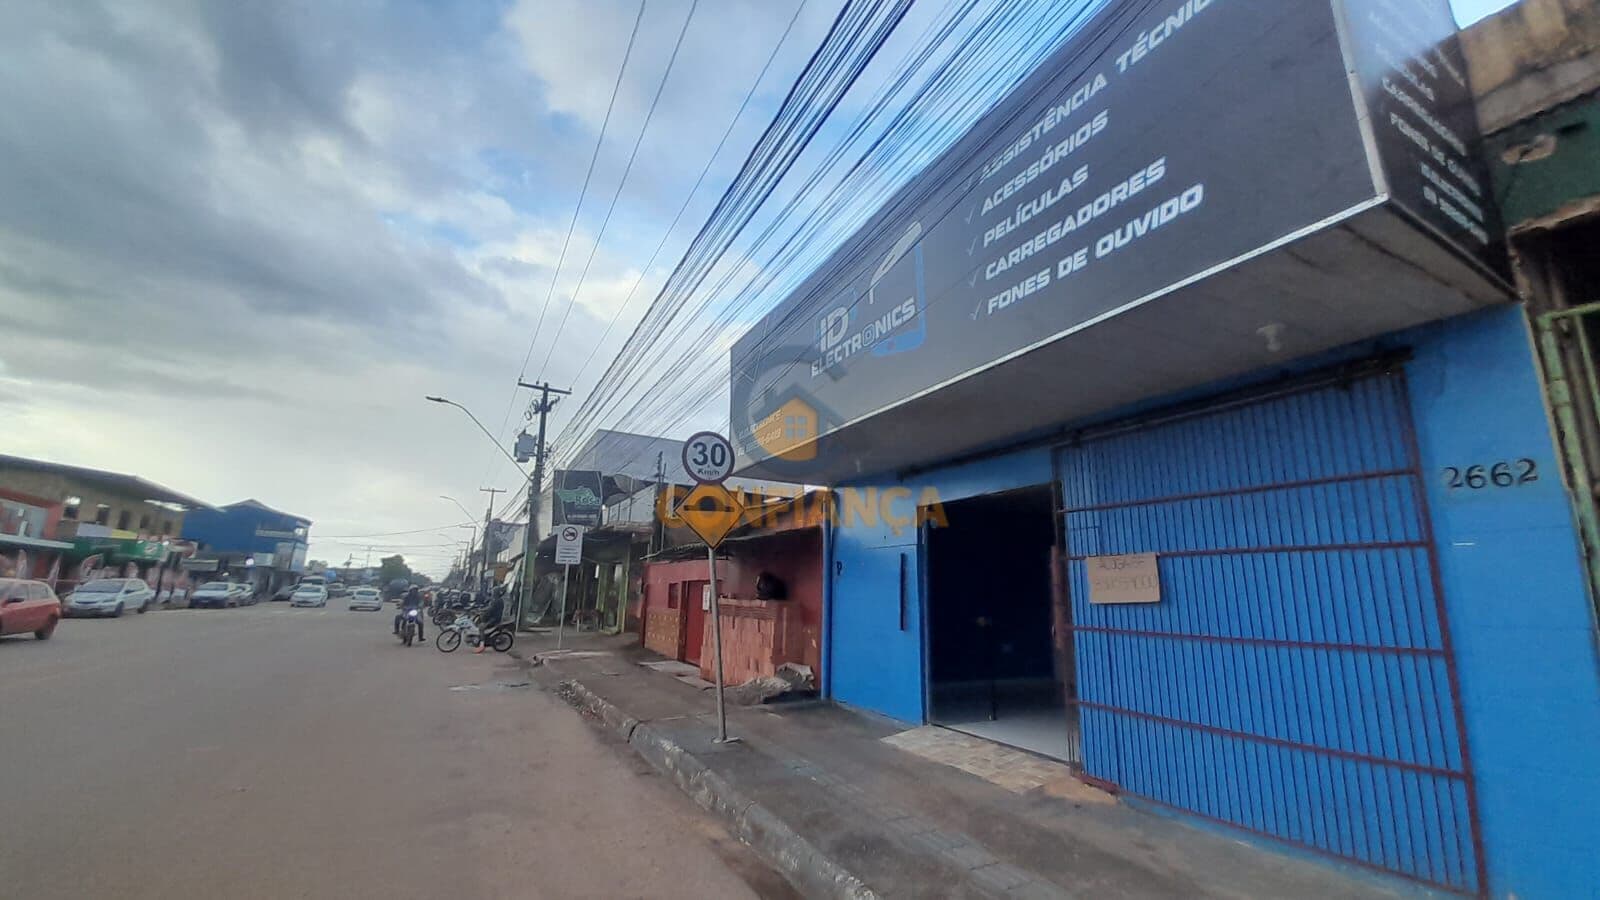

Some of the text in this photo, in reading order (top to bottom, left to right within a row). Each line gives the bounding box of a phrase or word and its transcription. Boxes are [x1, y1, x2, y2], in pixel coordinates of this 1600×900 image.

[981, 109, 1109, 216] ACESSÓRIOS
[983, 164, 1089, 248] PELÍCULAS
[985, 156, 1167, 281] CARREGADORES
[987, 183, 1205, 315] FONES DE OUVIDO
[692, 441, 726, 467] 30
[1442, 457, 1539, 489] 2662
